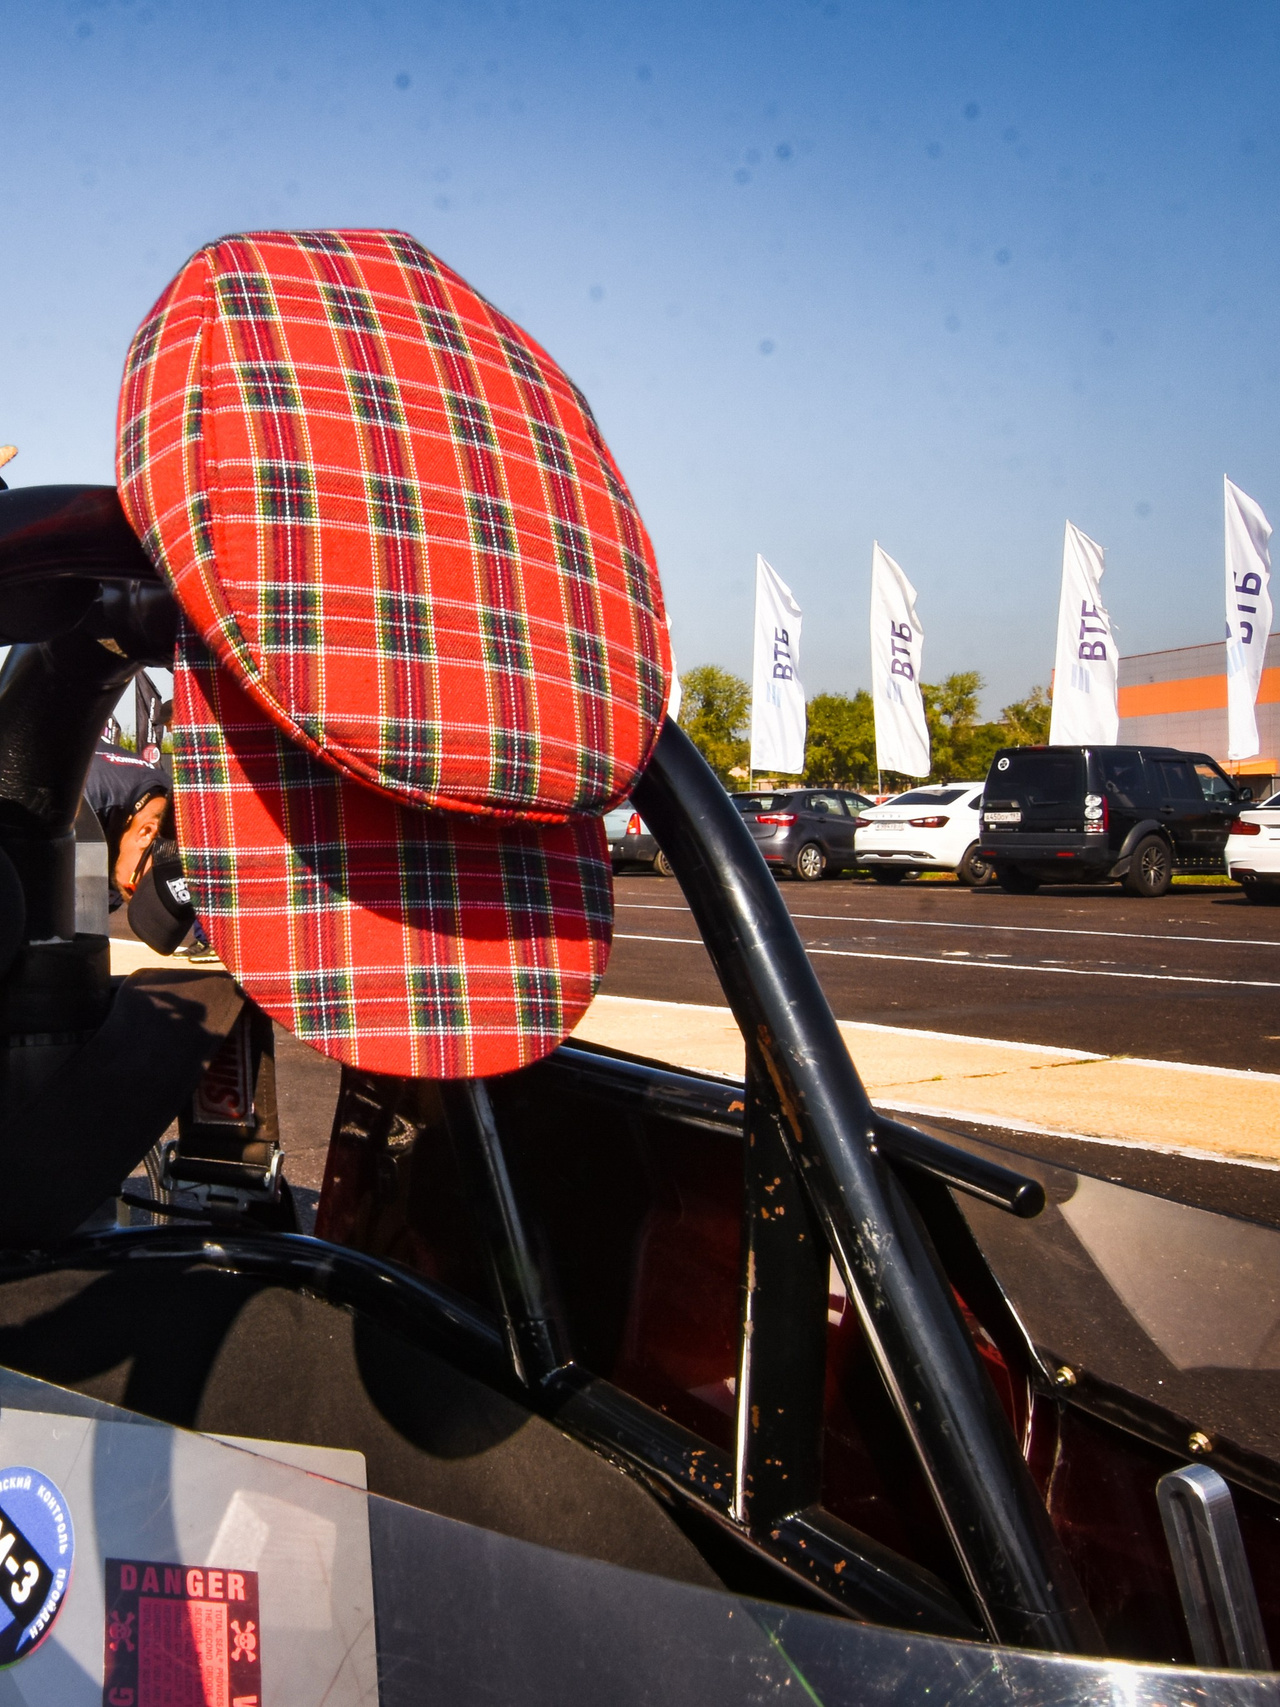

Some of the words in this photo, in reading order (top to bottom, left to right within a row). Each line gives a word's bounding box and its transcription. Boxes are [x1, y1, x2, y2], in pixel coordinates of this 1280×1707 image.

[773, 627, 793, 681] ВТБ
[891, 620, 914, 682] ВТБ
[36, 1484, 68, 1554] КОНТРОЛЬ
[28, 1568, 67, 1639] ПРОЙДЕН
[120, 1564, 246, 1601] DANGER
[215, 1609, 223, 1633] TOTAL
